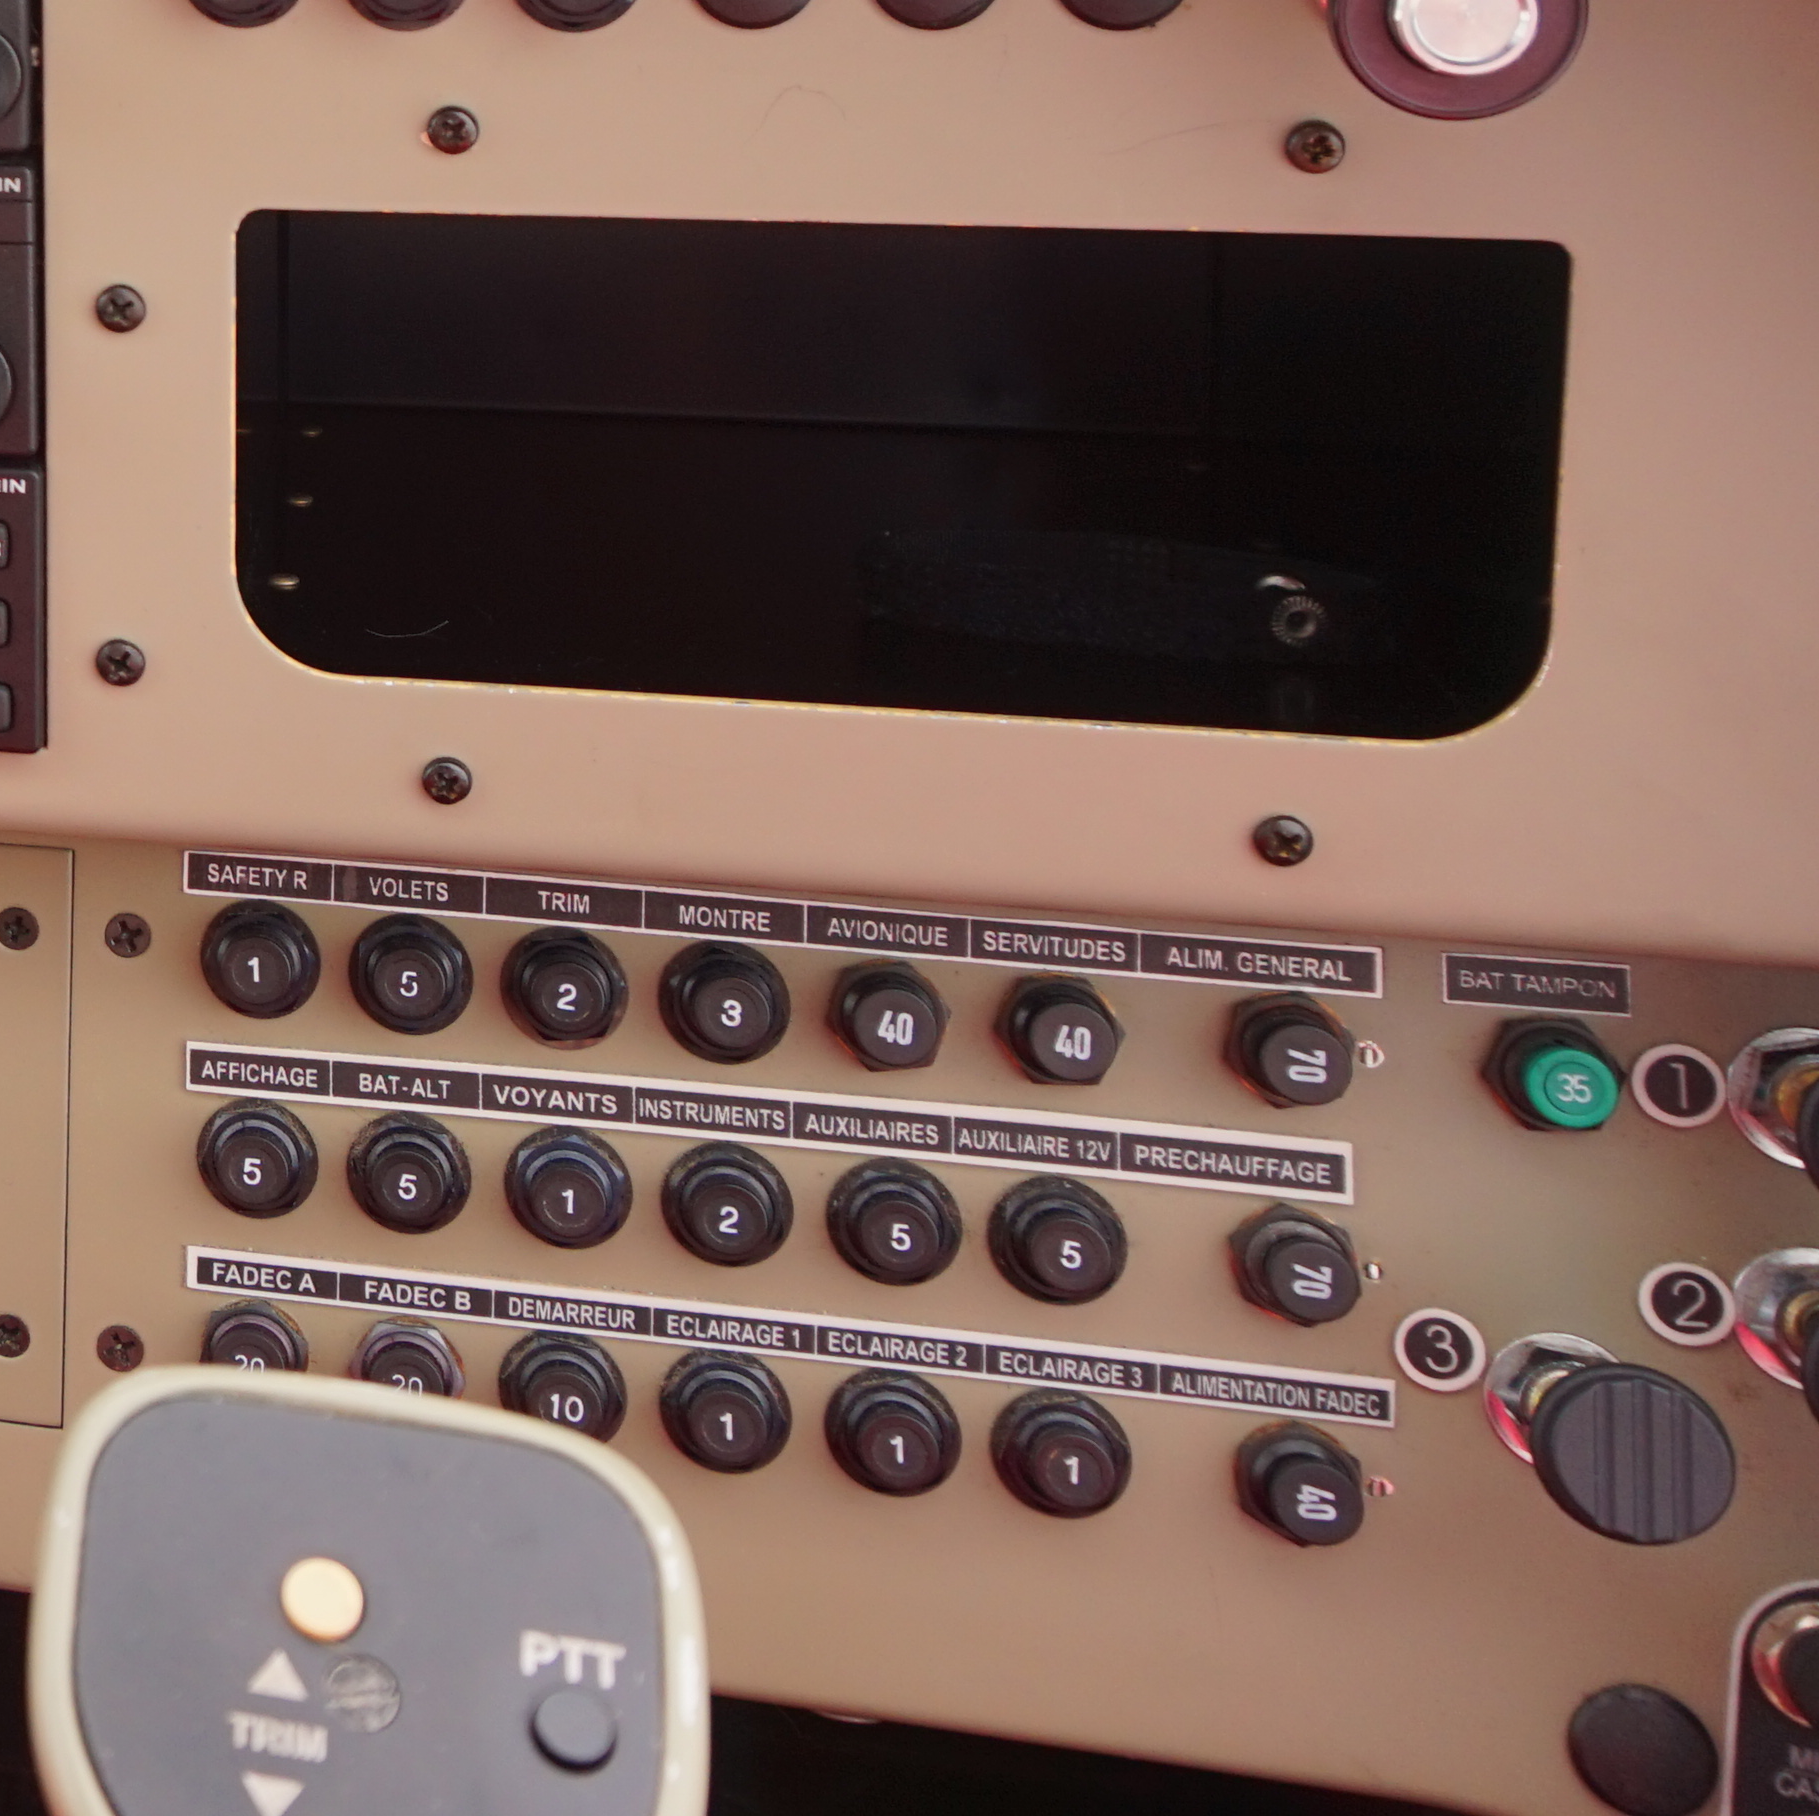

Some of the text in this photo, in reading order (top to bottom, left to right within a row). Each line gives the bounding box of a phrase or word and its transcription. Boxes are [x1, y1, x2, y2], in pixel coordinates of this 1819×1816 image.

[208, 862, 307, 890] SAFETY R
[369, 876, 449, 902] VOLETS
[538, 891, 590, 914] TRIM
[679, 905, 772, 935] MONTRE
[827, 917, 948, 948] AVIONIQUE
[983, 930, 1125, 963] SERVITUDES
[1167, 947, 1353, 983] ALIM. GENERAL
[1460, 970, 1616, 998] BAT TAMPON
[201, 1060, 318, 1088] AFFICHAGE
[359, 1073, 450, 1100] BAT-ALT
[1557, 1074, 1592, 1104] 35
[493, 1084, 617, 1115] VOYANTS
[638, 1097, 785, 1132] INSTRUMENTS
[806, 1114, 940, 1145] AUXILIAIRES
[959, 1127, 1111, 1162] AUXILIAIRE 12V
[1135, 1144, 1331, 1184] PRECHAUFFAGE
[508, 1296, 637, 1330] DEMARREUR
[1171, 1373, 1381, 1417] ALIMENTATION FADEC
[518, 1631, 626, 1688] PTT
